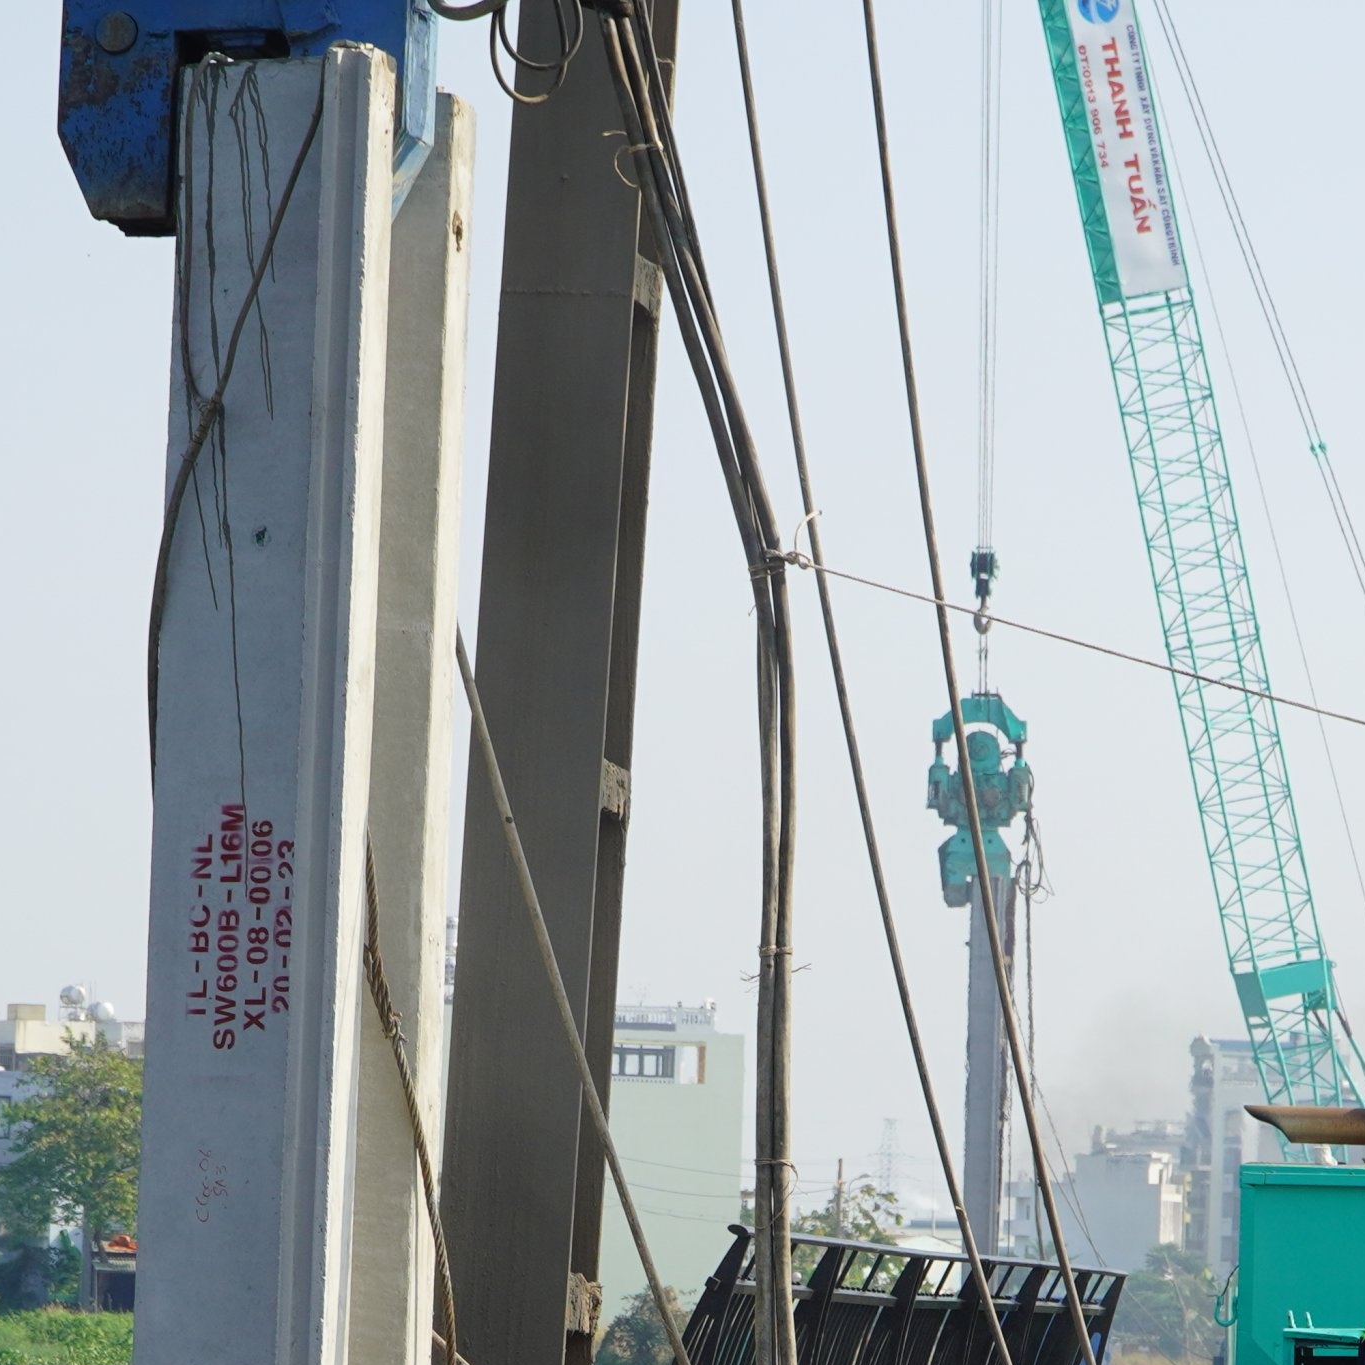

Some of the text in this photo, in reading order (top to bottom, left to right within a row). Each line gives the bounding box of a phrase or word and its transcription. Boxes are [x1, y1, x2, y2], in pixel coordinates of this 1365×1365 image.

[1097, 141, 1109, 169] 734
[1102, 36, 1157, 234] THANH TUẤN
[213, 803, 246, 1051] SW600B-L16M
